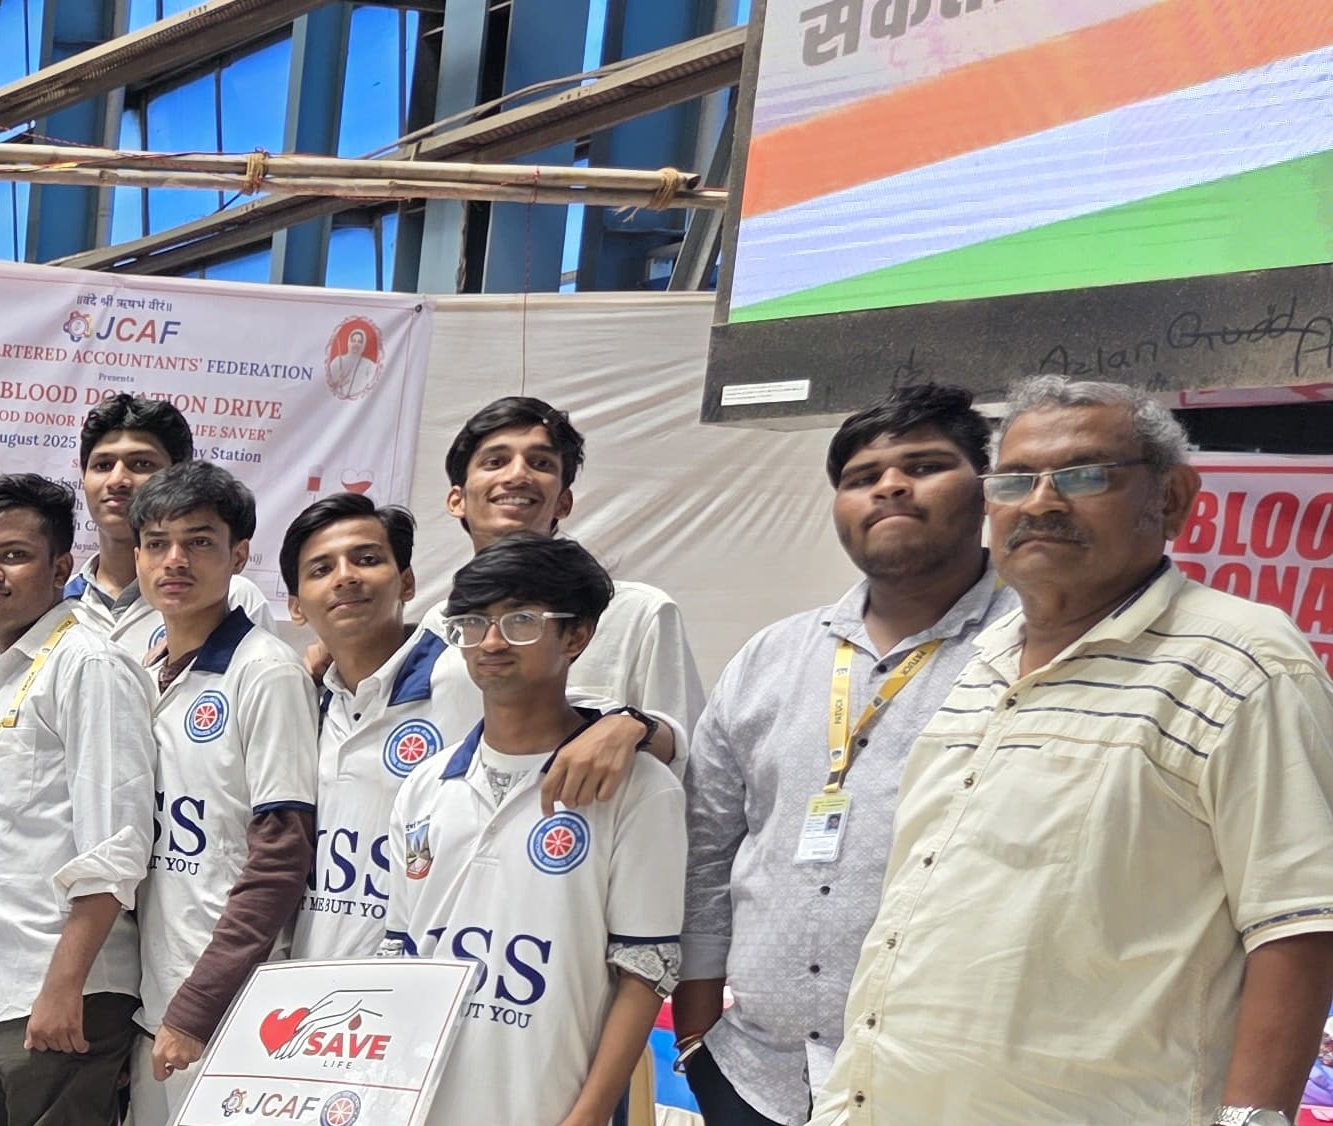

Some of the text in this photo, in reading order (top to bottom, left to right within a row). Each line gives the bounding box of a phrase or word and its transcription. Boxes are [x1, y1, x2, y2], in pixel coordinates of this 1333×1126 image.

[96, 316, 181, 345] JCAF
[207, 359, 314, 381] FEDERATION
[0, 381, 78, 404] BLOOD
[213, 397, 283, 420] DRIVE
[24, 411, 75, 427] DONOR
[43, 434, 77, 449] 2025
[210, 446, 262, 463] Station
[165, 856, 200, 876] YOU
[489, 1005, 532, 1029] YOU
[303, 1031, 392, 1060] SAVE
[323, 1060, 353, 1070] LIFE
[245, 1092, 321, 1120] JCAF
